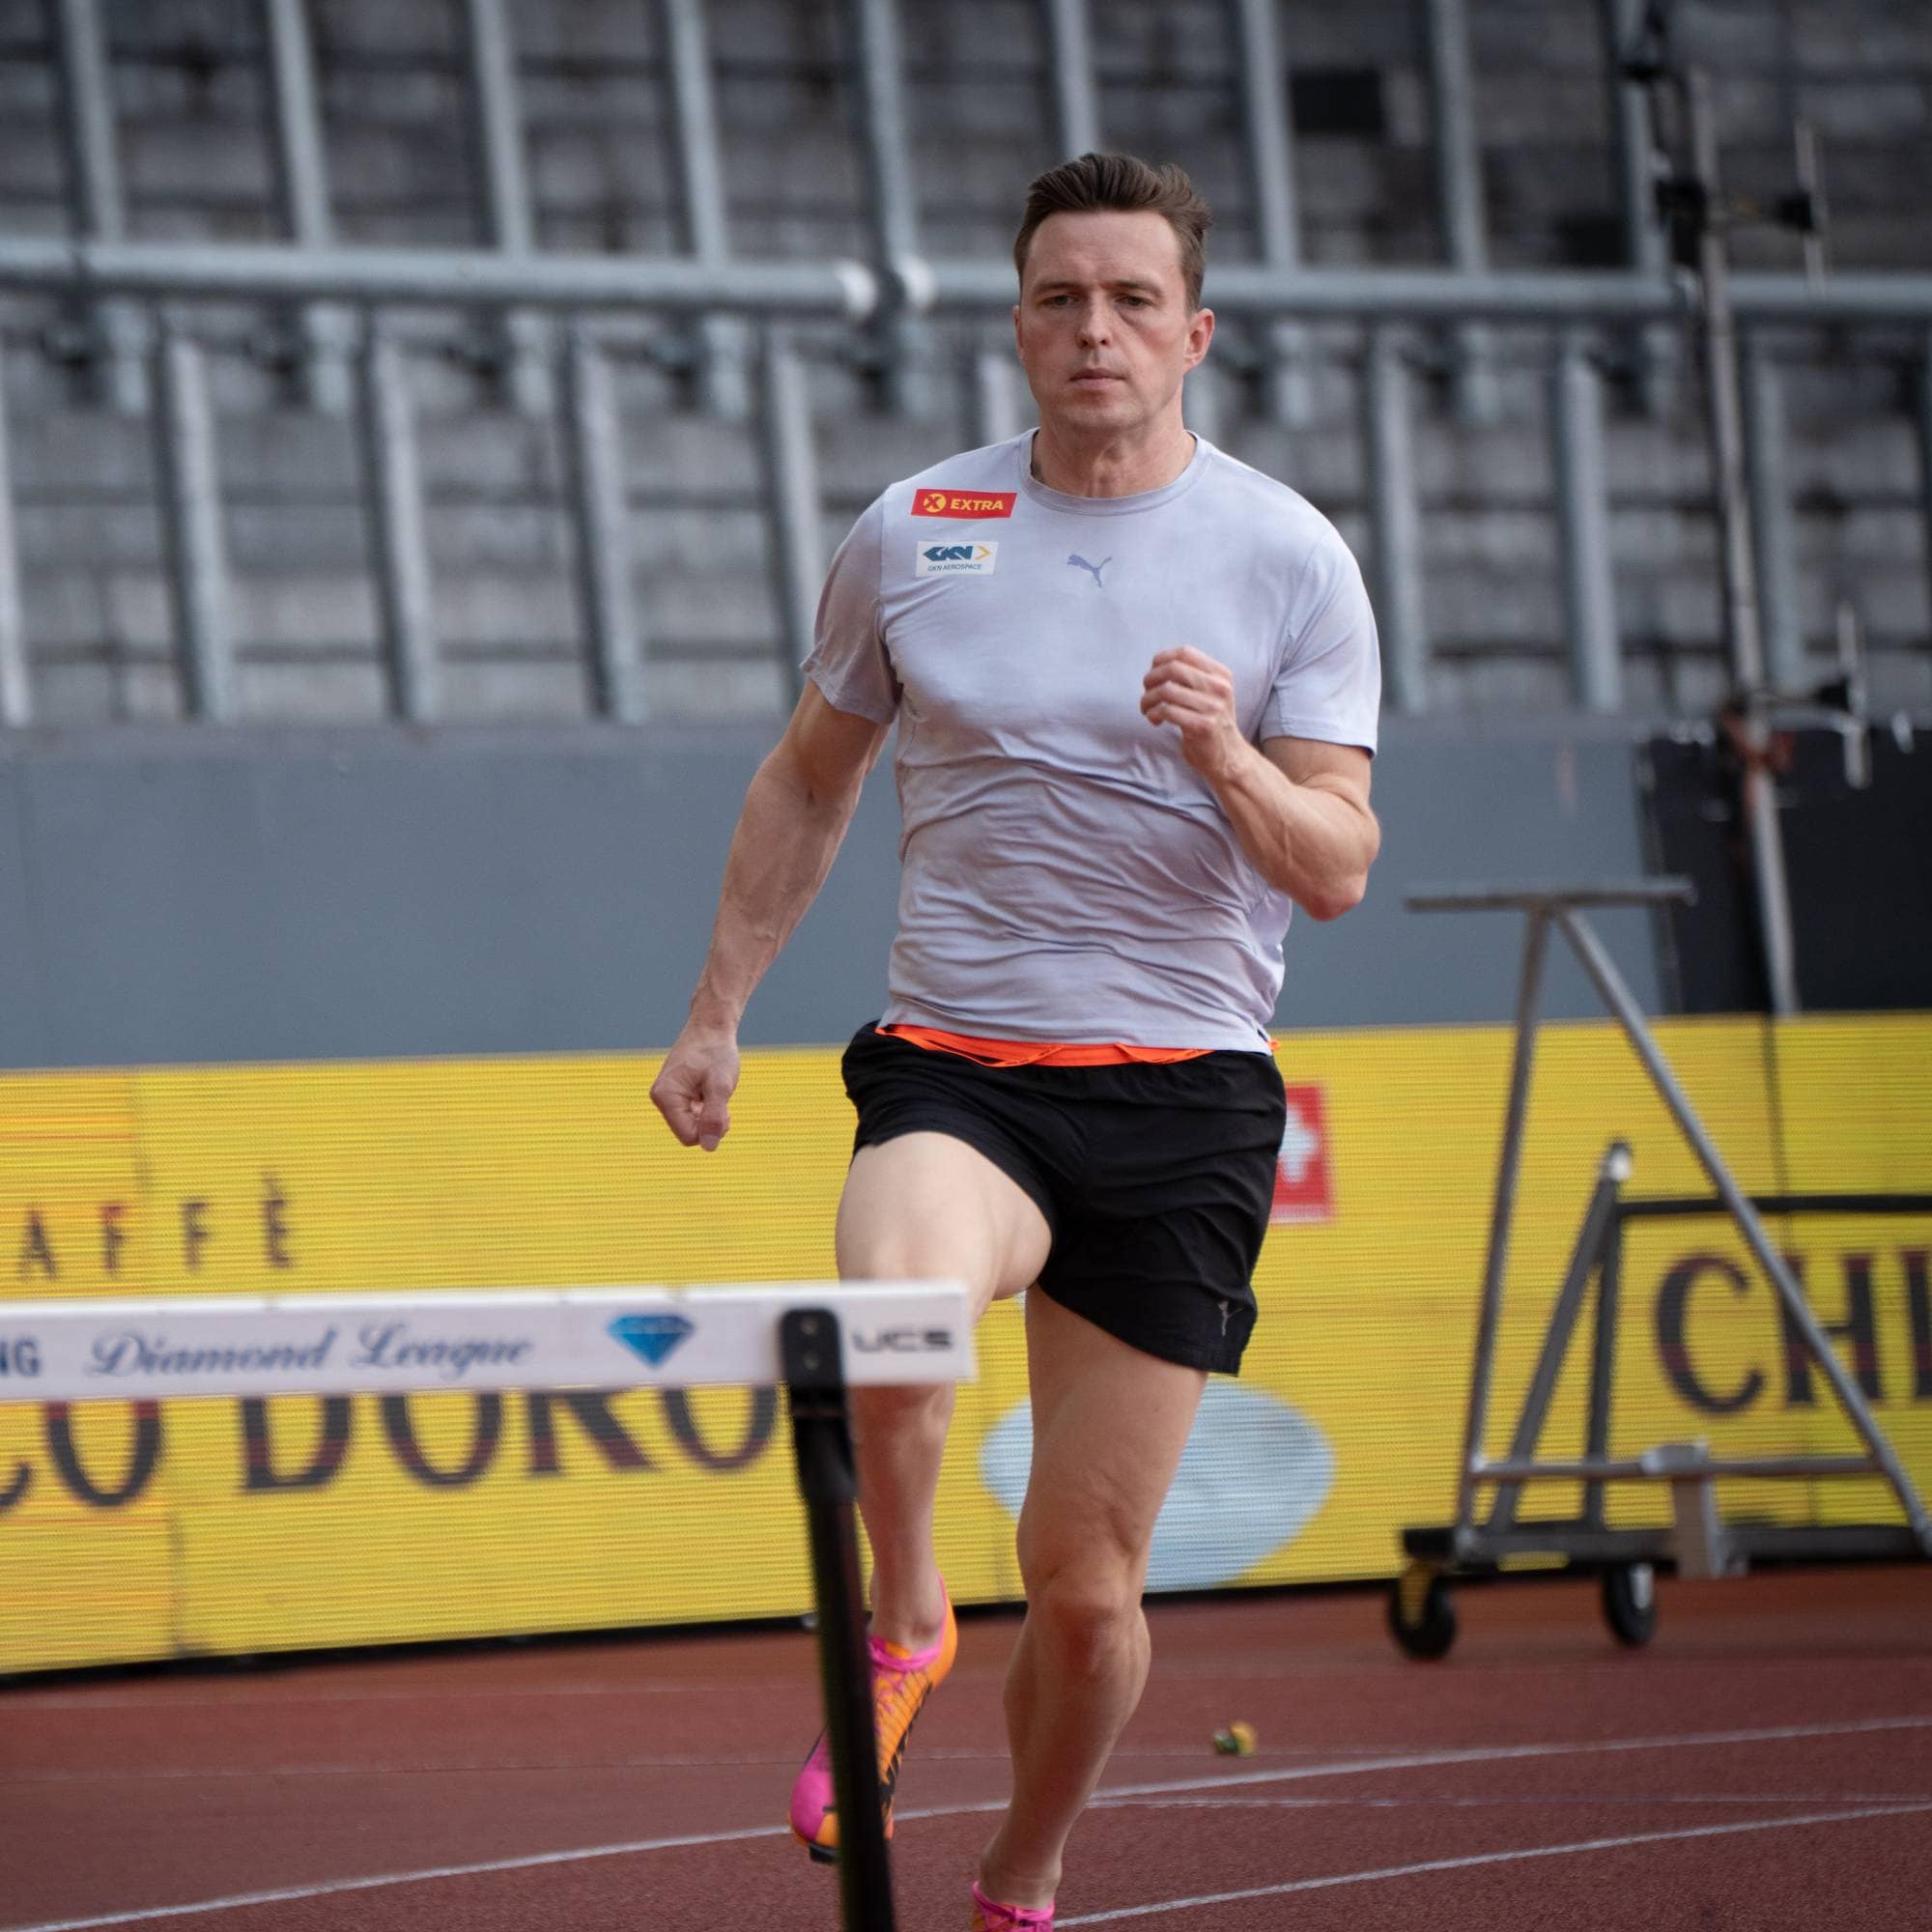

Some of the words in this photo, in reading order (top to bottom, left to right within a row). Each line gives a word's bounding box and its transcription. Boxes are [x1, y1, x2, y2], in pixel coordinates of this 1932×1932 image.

[950, 498, 1004, 511] EXTRA
[85, 1326, 337, 1377] Diamond
[348, 1318, 532, 1381] League
[852, 1330, 953, 1353] UCS
